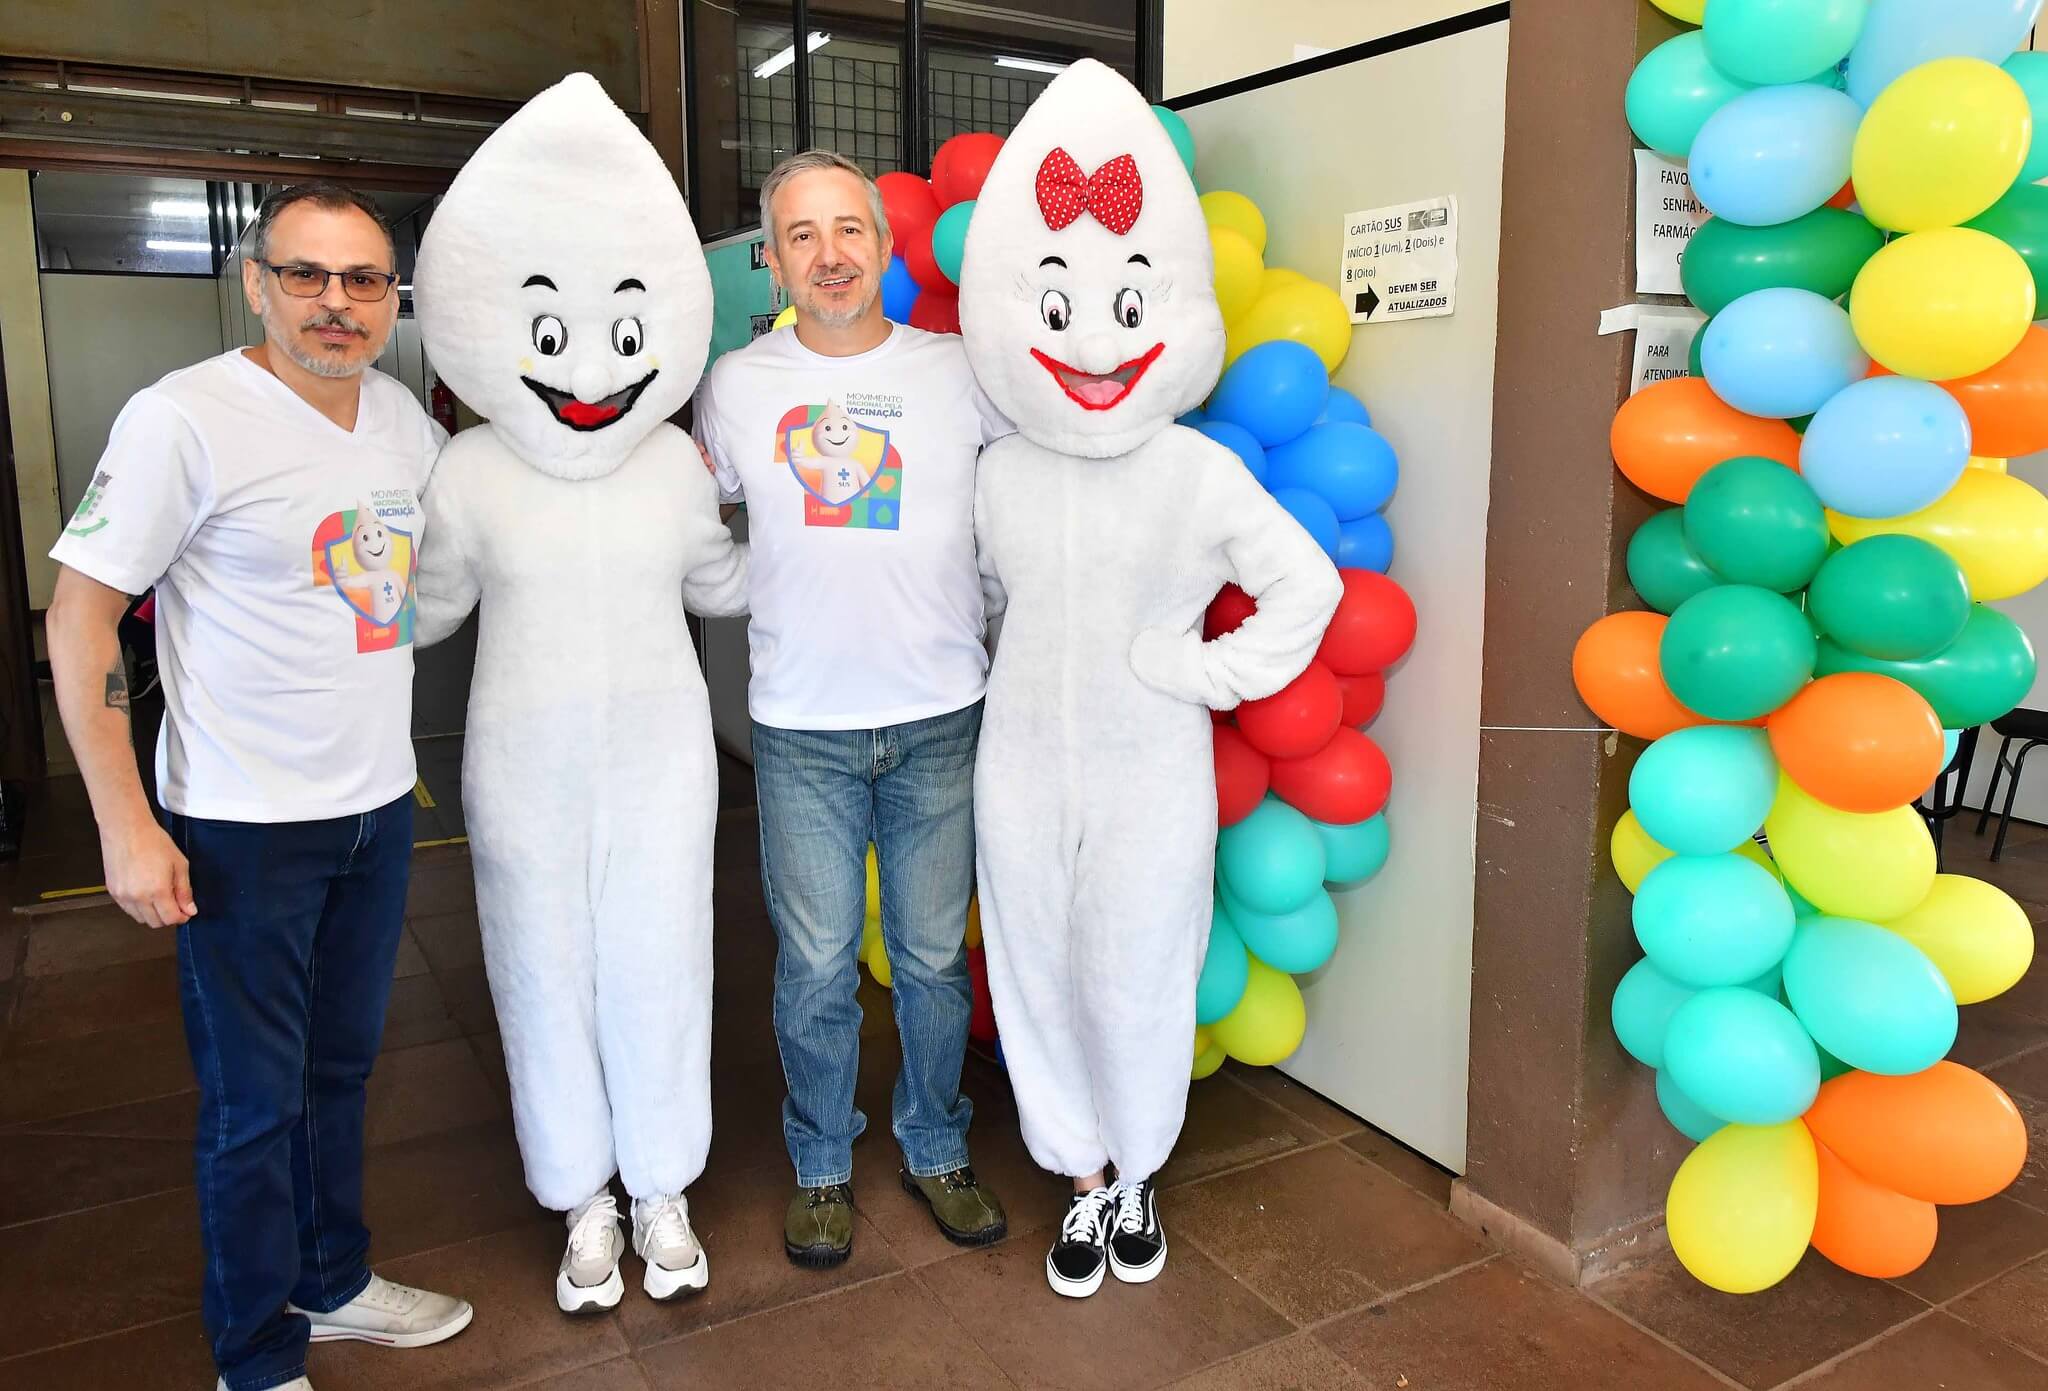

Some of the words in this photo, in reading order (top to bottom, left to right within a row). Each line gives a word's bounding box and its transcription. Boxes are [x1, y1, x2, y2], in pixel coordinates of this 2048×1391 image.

[1660, 170, 1691, 186] FAVO
[1663, 197, 1696, 213] SENHA
[1350, 220, 1383, 236] CARTÃO
[1384, 216, 1402, 231] SUS
[1347, 245, 1373, 259] INÍCIO
[1374, 244, 1379, 256] 1
[1405, 239, 1411, 251] 2
[1413, 234, 1437, 251] (Dois)
[1439, 236, 1445, 245] e
[1346, 269, 1352, 281] 8
[1354, 266, 1376, 280] (Oito)
[1388, 283, 1418, 295] DEVEM
[1420, 280, 1437, 291] SER
[1387, 296, 1447, 312] ATUALIZADOS
[1647, 344, 1669, 357] PARA
[846, 392, 903, 403] MOVIMENTO
[846, 400, 882, 408] NACIONAL
[847, 407, 903, 418] VACINAÇÃO
